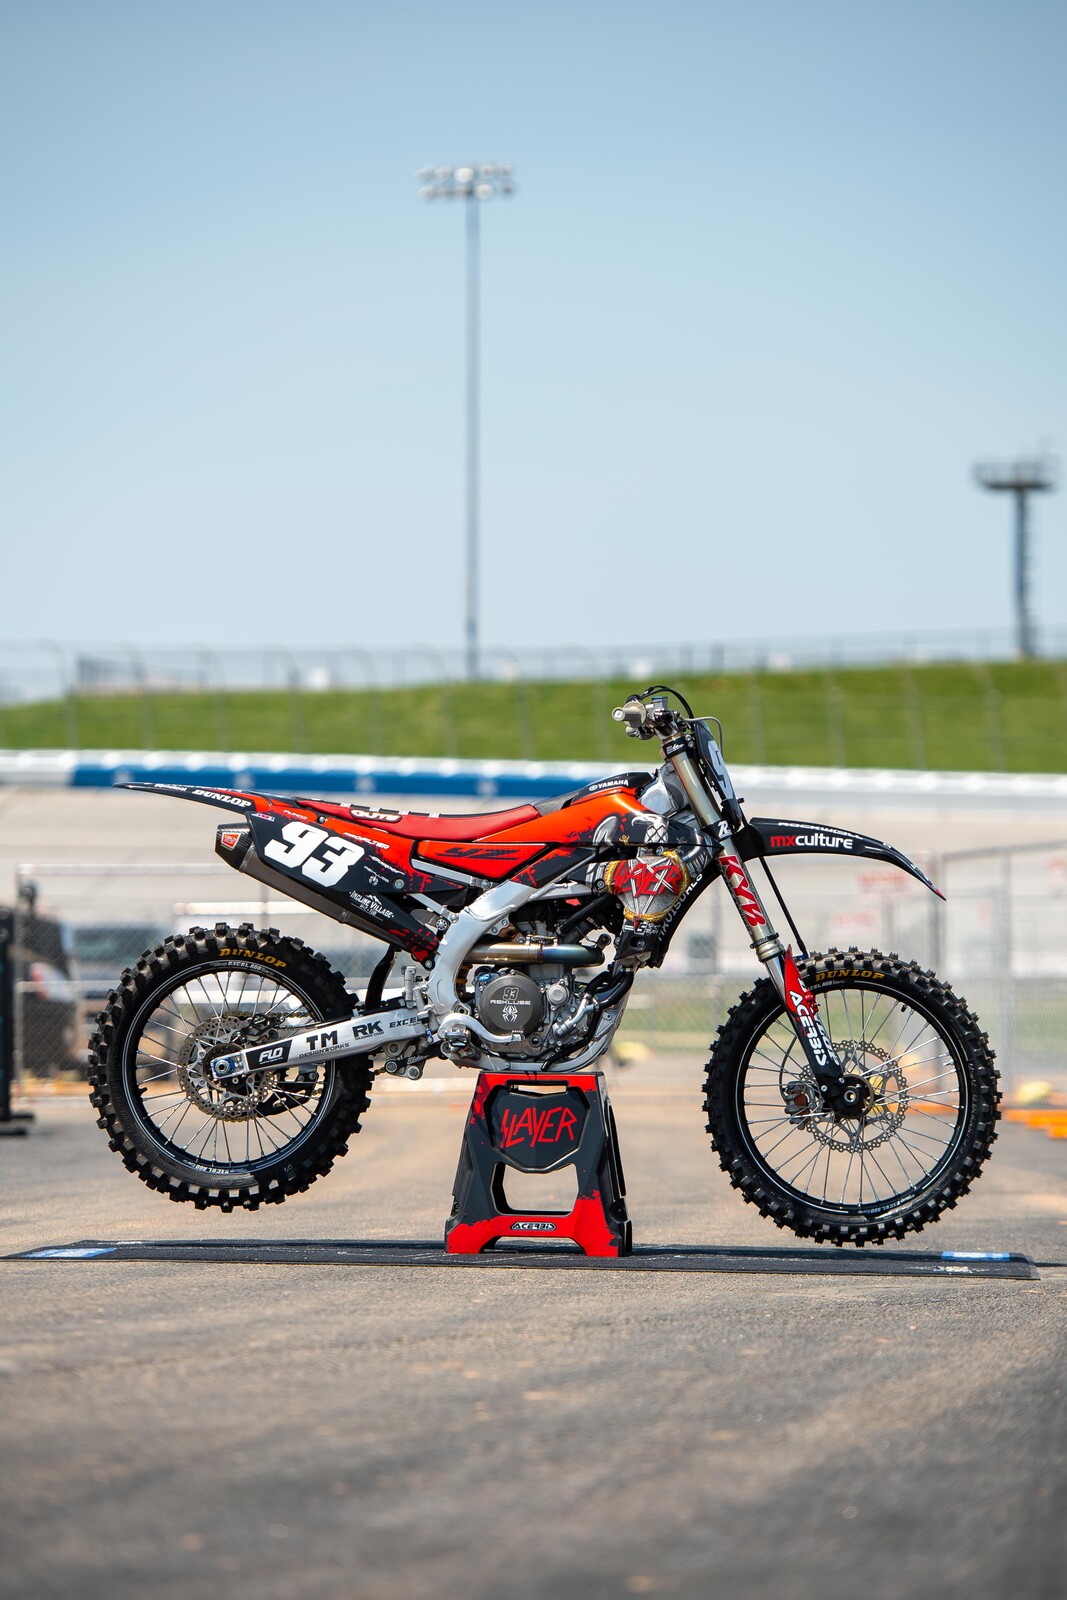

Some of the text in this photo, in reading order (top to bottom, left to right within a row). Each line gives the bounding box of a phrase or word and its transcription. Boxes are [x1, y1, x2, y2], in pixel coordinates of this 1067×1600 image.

[598, 779, 629, 789] YAMAHA
[192, 789, 252, 808] DUNLOP
[264, 821, 365, 887] 93
[613, 859, 683, 898] SLAYER
[719, 855, 767, 928] KYB
[219, 948, 287, 968] DUNLOP
[815, 969, 885, 982] DUNLOP
[502, 986, 520, 1000] 93
[352, 1020, 382, 1037] RK
[789, 990, 828, 1067] ACERBIS
[306, 1030, 339, 1050] TM
[259, 1047, 284, 1062] FLO
[299, 1042, 350, 1059] DESIGNWORKS
[500, 1106, 578, 1149] SLAYER
[512, 1222, 556, 1231] ACERBIS
